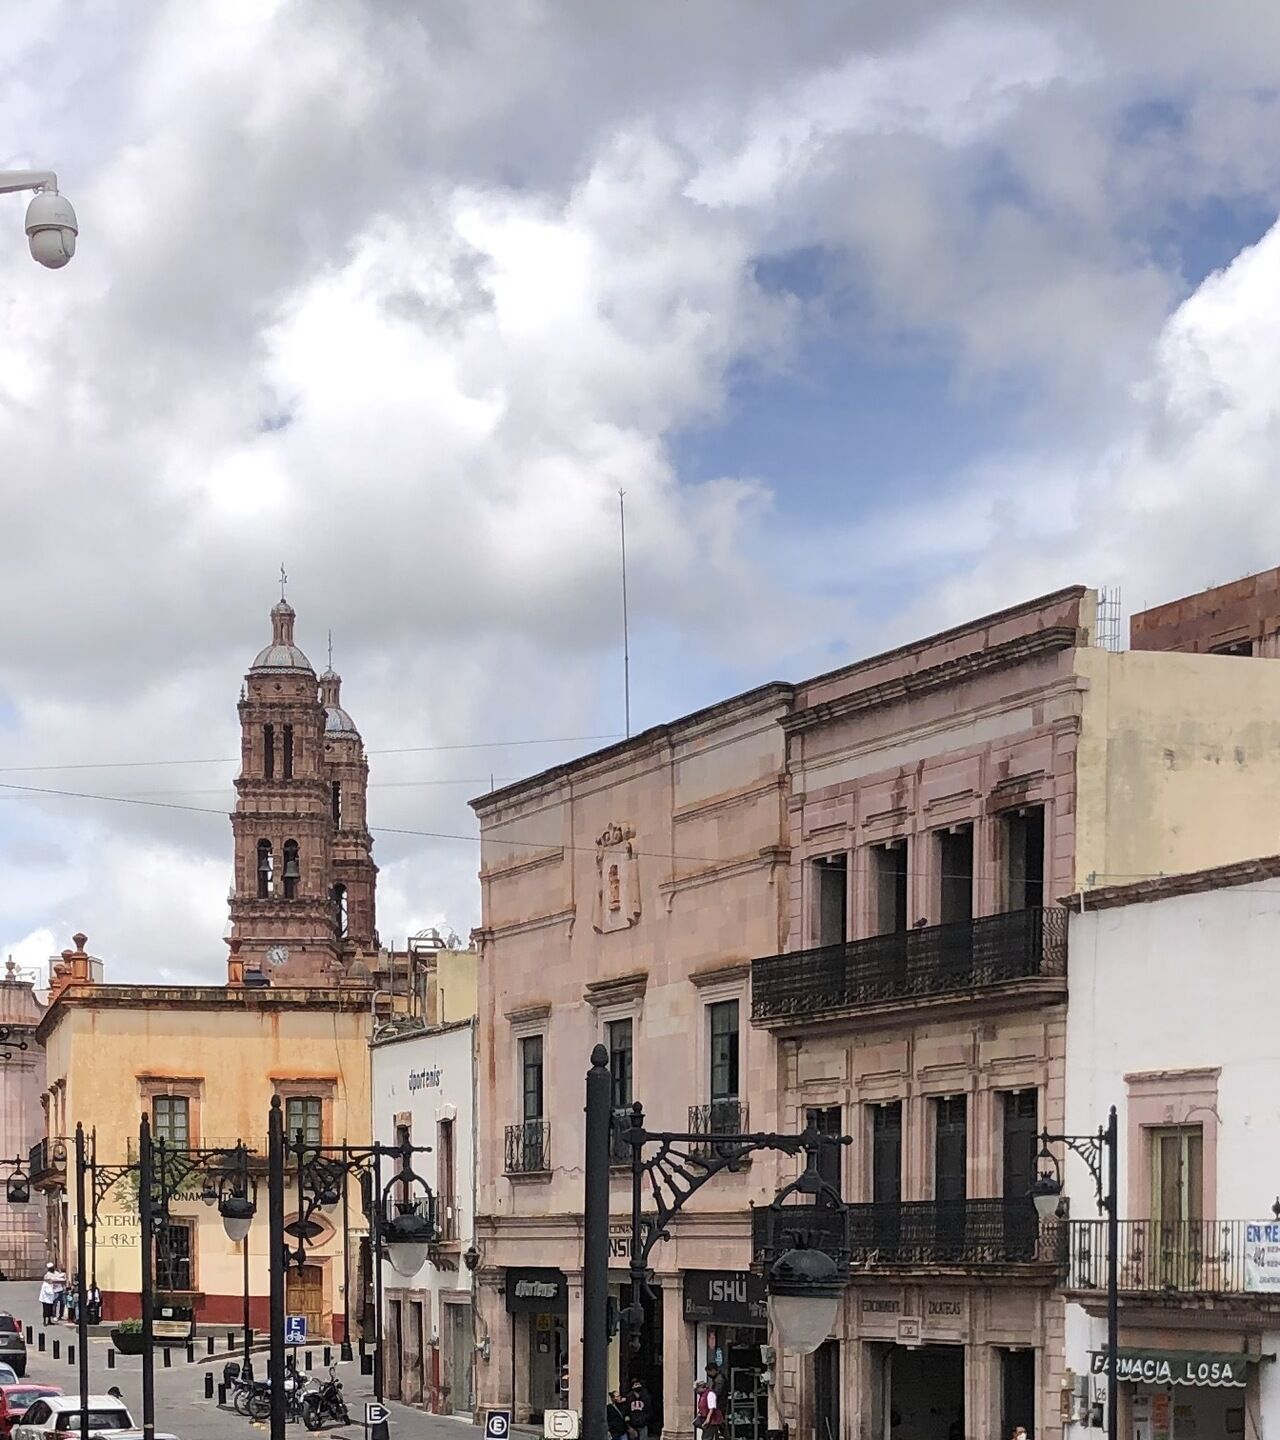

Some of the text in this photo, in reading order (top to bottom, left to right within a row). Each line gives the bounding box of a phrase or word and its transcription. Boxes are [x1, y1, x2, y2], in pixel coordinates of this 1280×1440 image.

[1247, 1225, 1261, 1242] EN
[291, 1318, 301, 1329] E
[1186, 1362, 1233, 1379] LOSA
[371, 1408, 381, 1419] E
[493, 1419, 503, 1431] E
[553, 1414, 568, 1433] E
